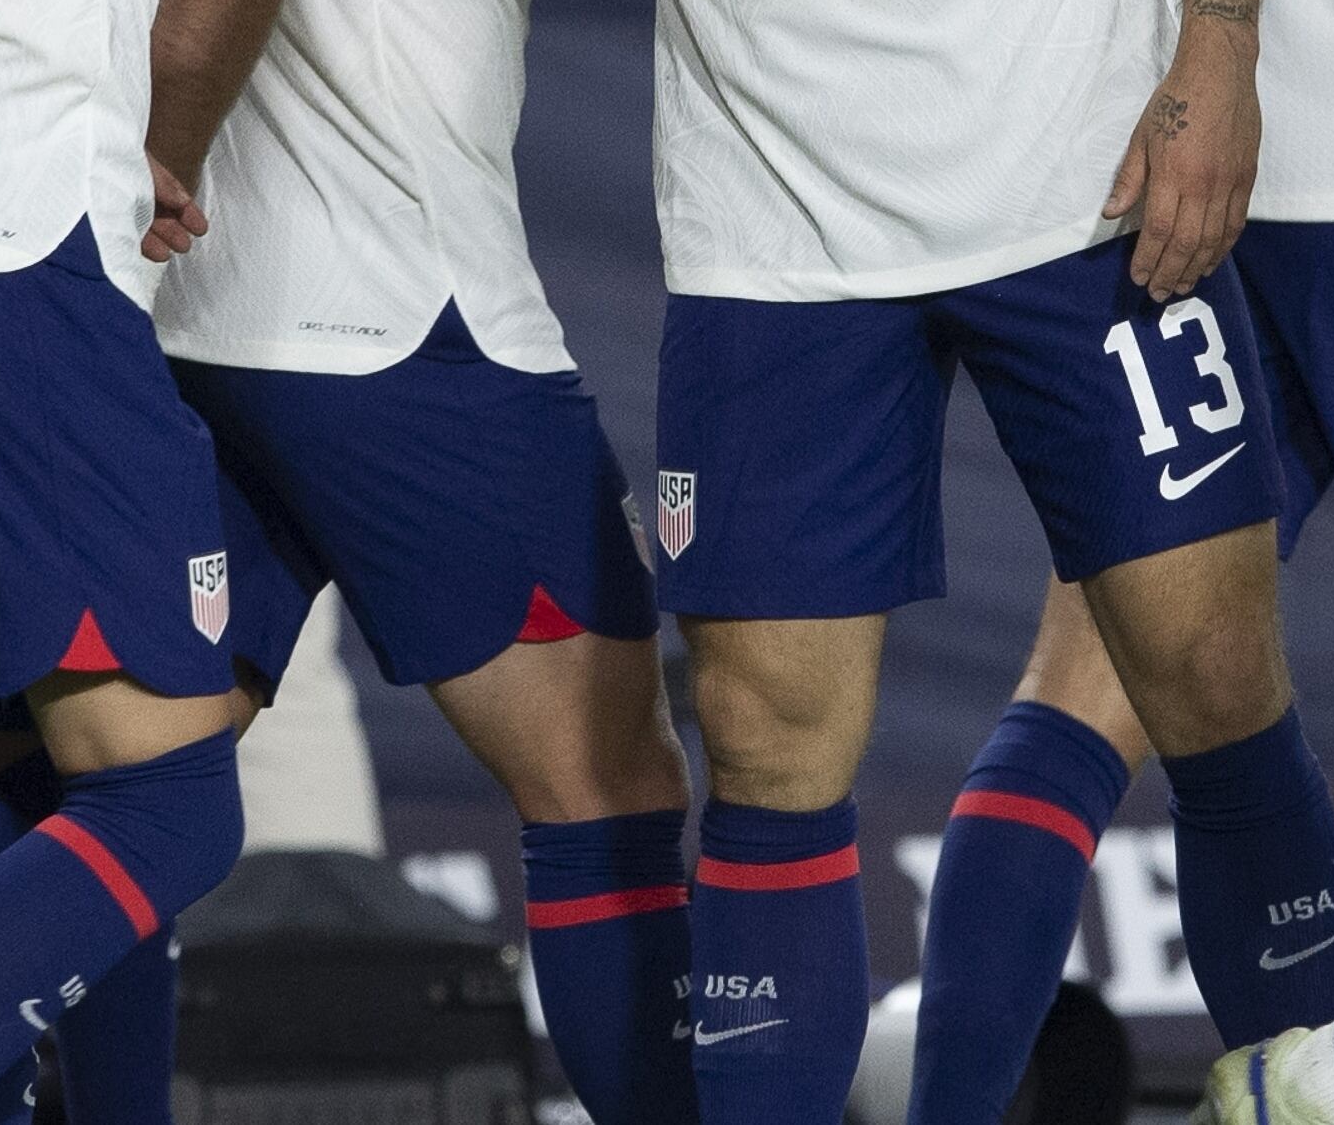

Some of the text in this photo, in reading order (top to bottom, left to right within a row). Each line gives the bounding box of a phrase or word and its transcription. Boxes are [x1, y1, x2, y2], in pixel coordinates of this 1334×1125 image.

[1103, 296, 1245, 457] 13
[659, 474, 693, 509] USA
[705, 974, 778, 999] USA
